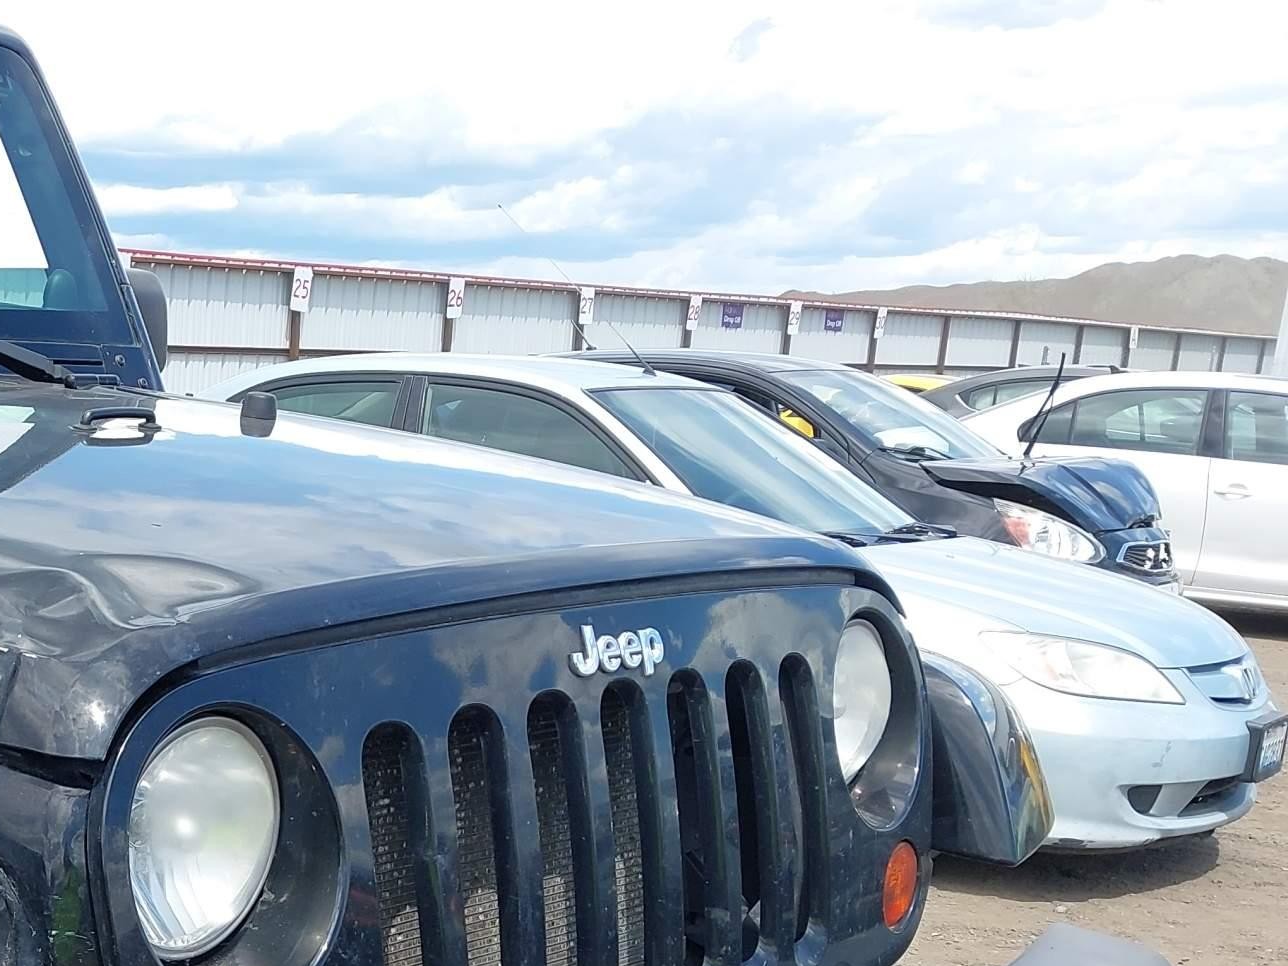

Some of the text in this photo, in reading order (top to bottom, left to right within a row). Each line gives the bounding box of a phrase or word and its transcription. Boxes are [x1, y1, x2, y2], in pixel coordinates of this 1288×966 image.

[293, 278, 310, 299] 25
[448, 289, 463, 308] 26
[581, 297, 594, 315] 27
[688, 305, 701, 320] 28
[789, 311, 801, 326] 29
[568, 624, 664, 677] Jeep
